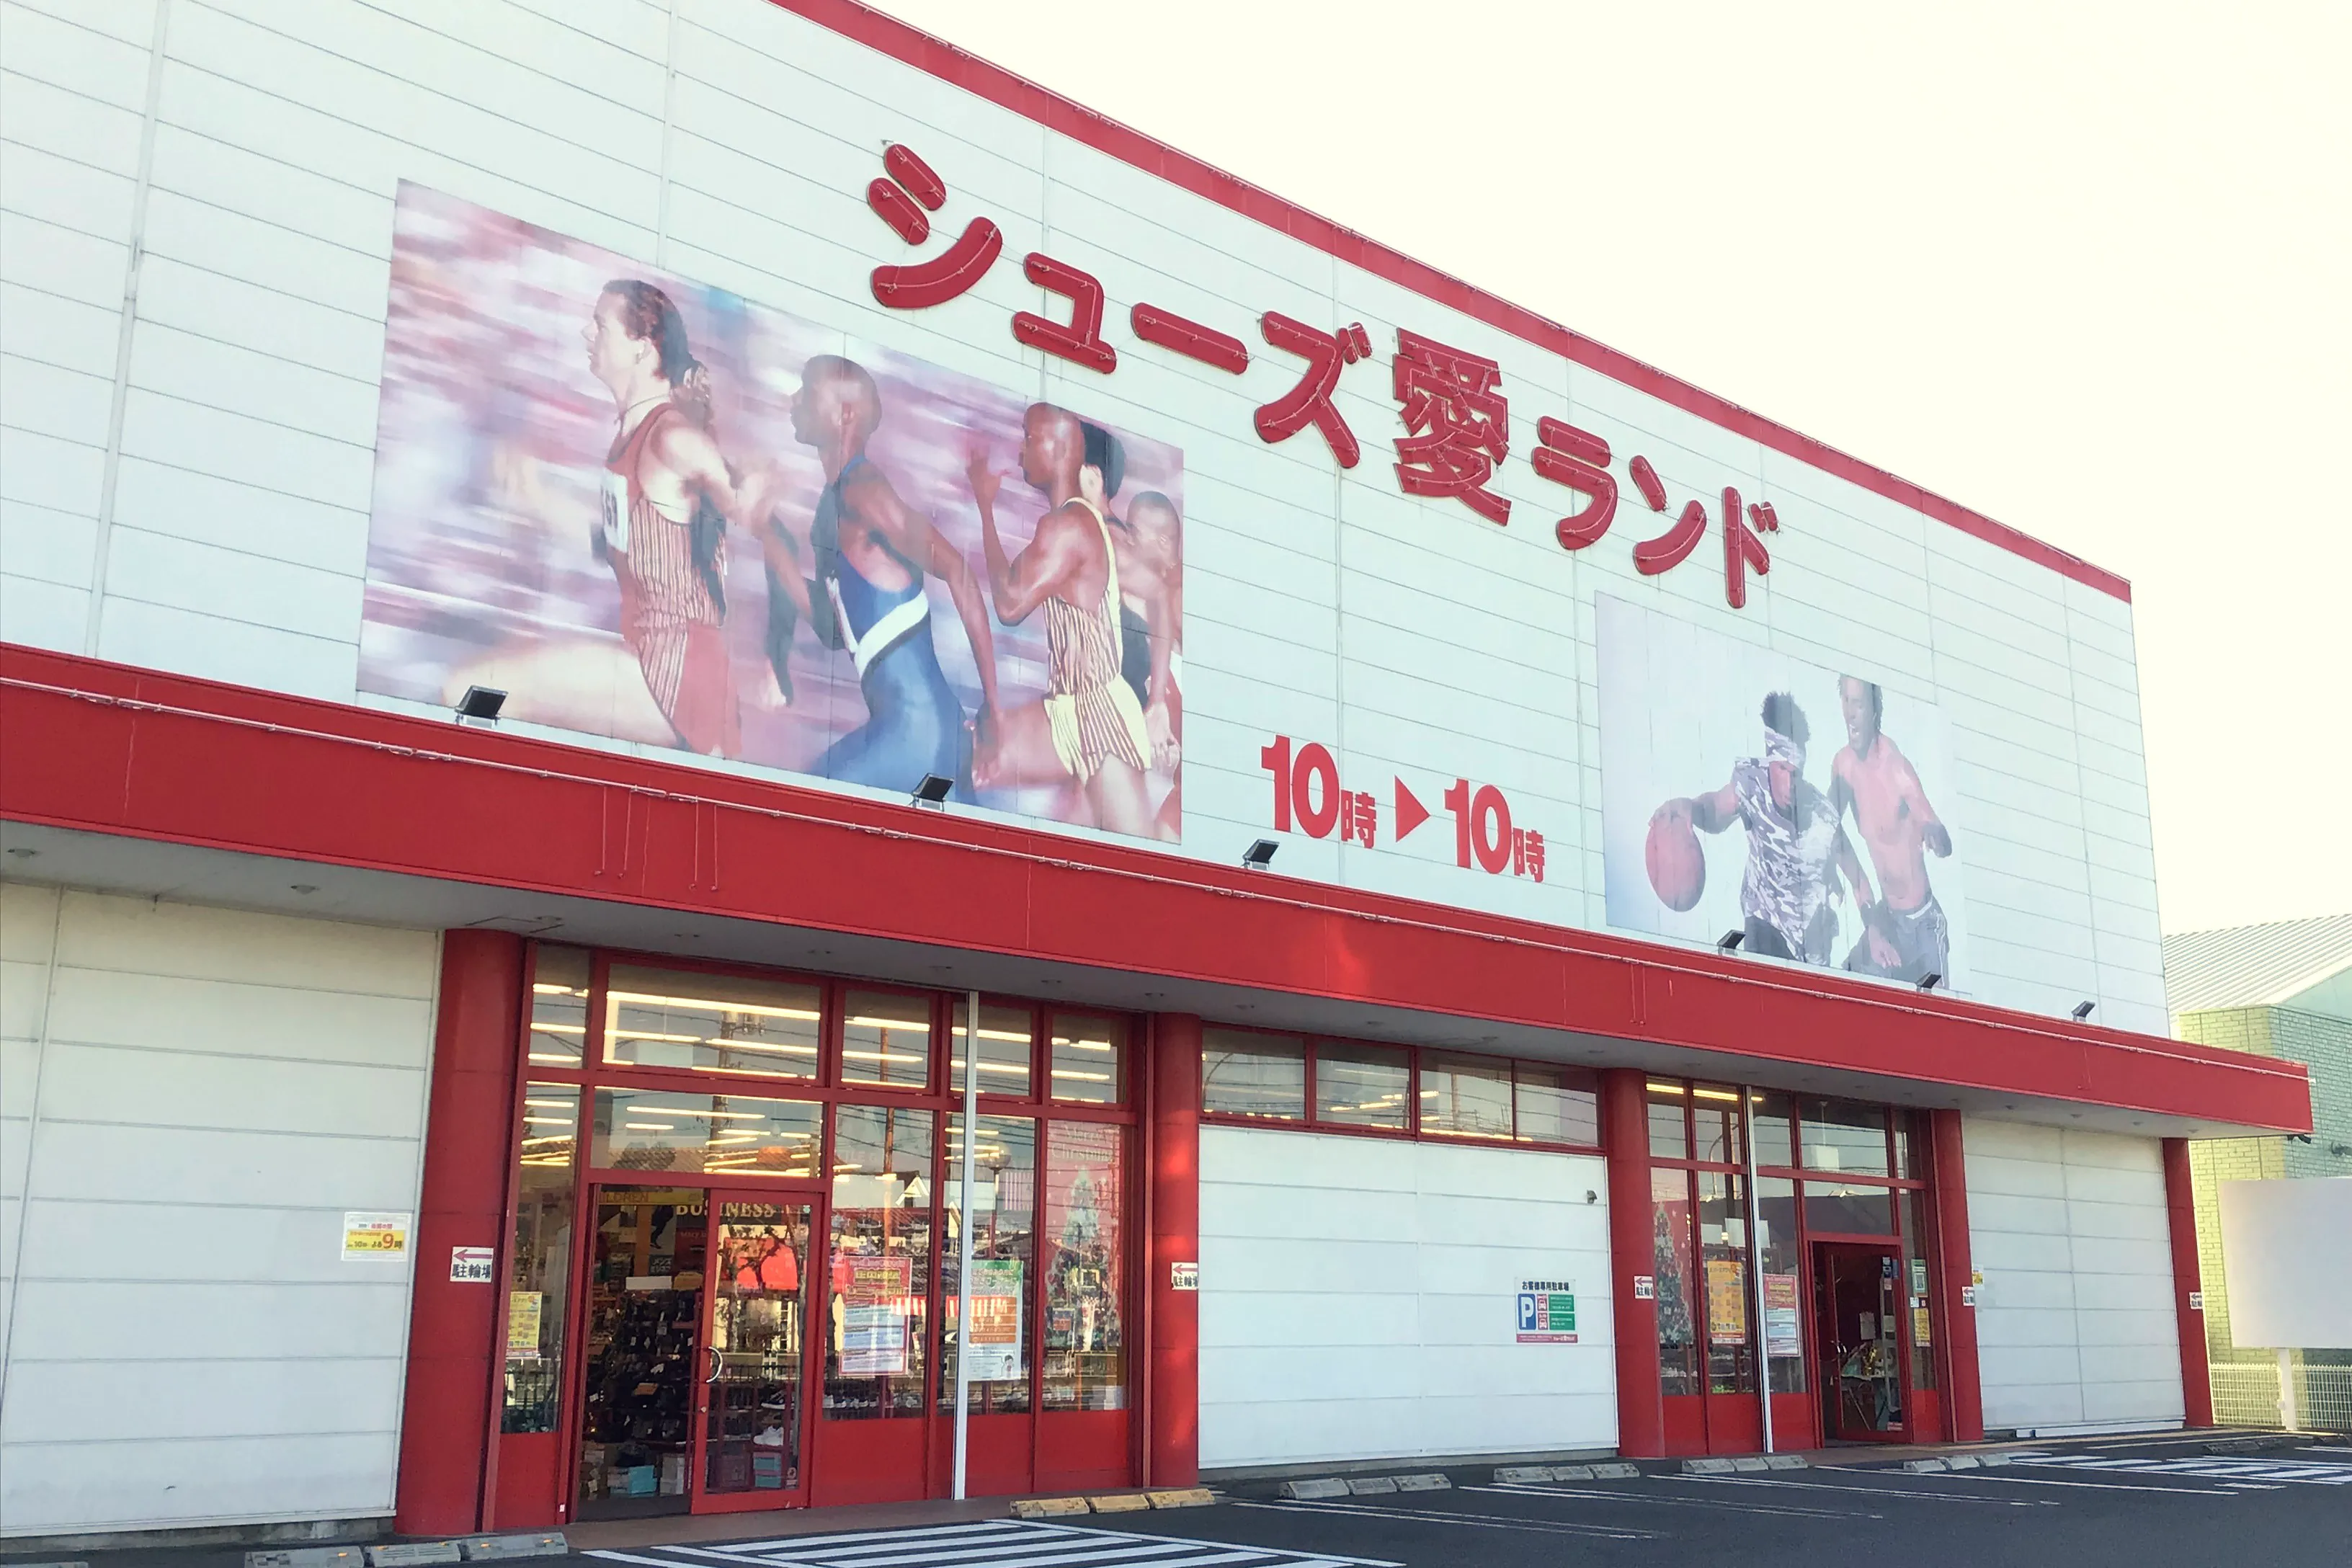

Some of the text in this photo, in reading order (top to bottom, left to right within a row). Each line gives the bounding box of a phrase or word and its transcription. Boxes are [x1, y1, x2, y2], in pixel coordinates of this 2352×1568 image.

[866, 143, 1780, 610] シューズ愛ランド
[1261, 734, 1545, 883] 10時 10時
[452, 1264, 491, 1278] 駐輪場
[1520, 1296, 1534, 1327] P
